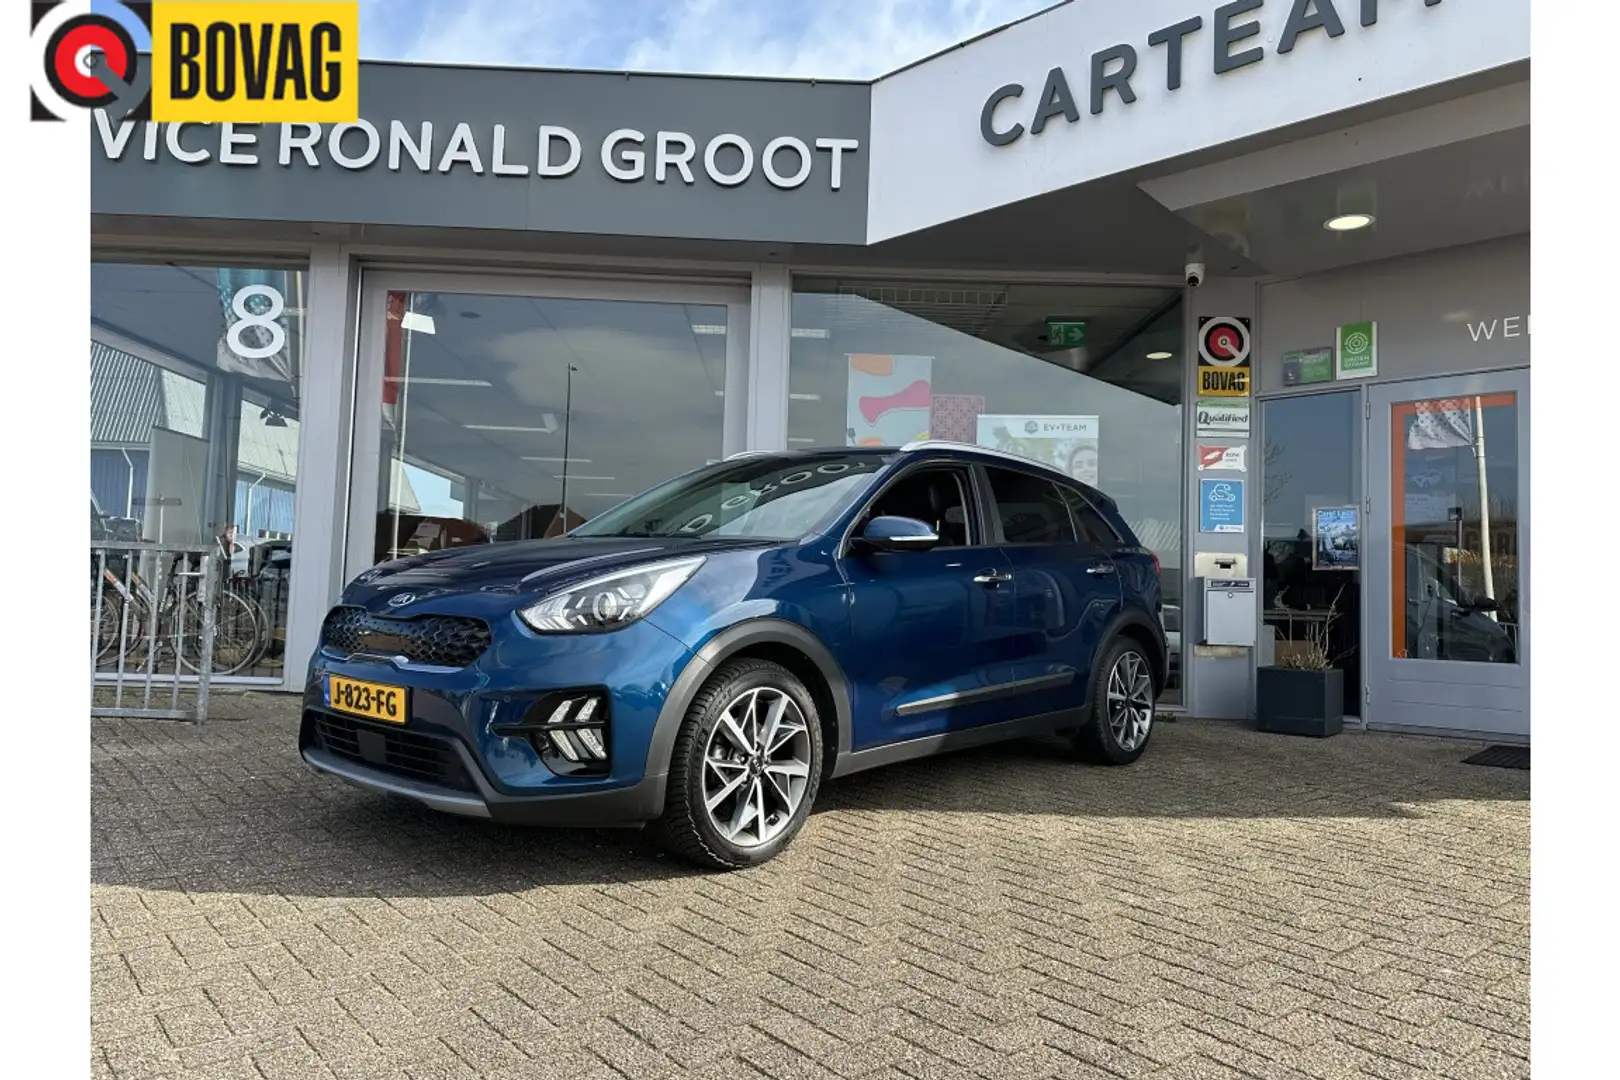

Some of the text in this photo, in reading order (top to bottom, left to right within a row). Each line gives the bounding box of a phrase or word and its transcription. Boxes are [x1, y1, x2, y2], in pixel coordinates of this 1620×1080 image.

[980, 0, 1442, 148] CARTEA
[278, 118, 582, 177] RONALD
[601, 128, 859, 191] GROOT
[227, 284, 285, 358] 8
[1467, 315, 1531, 342] WE
[1203, 370, 1245, 391] BOVAG
[1198, 410, 1249, 425] Qualified
[334, 681, 397, 717] J-823-FG
